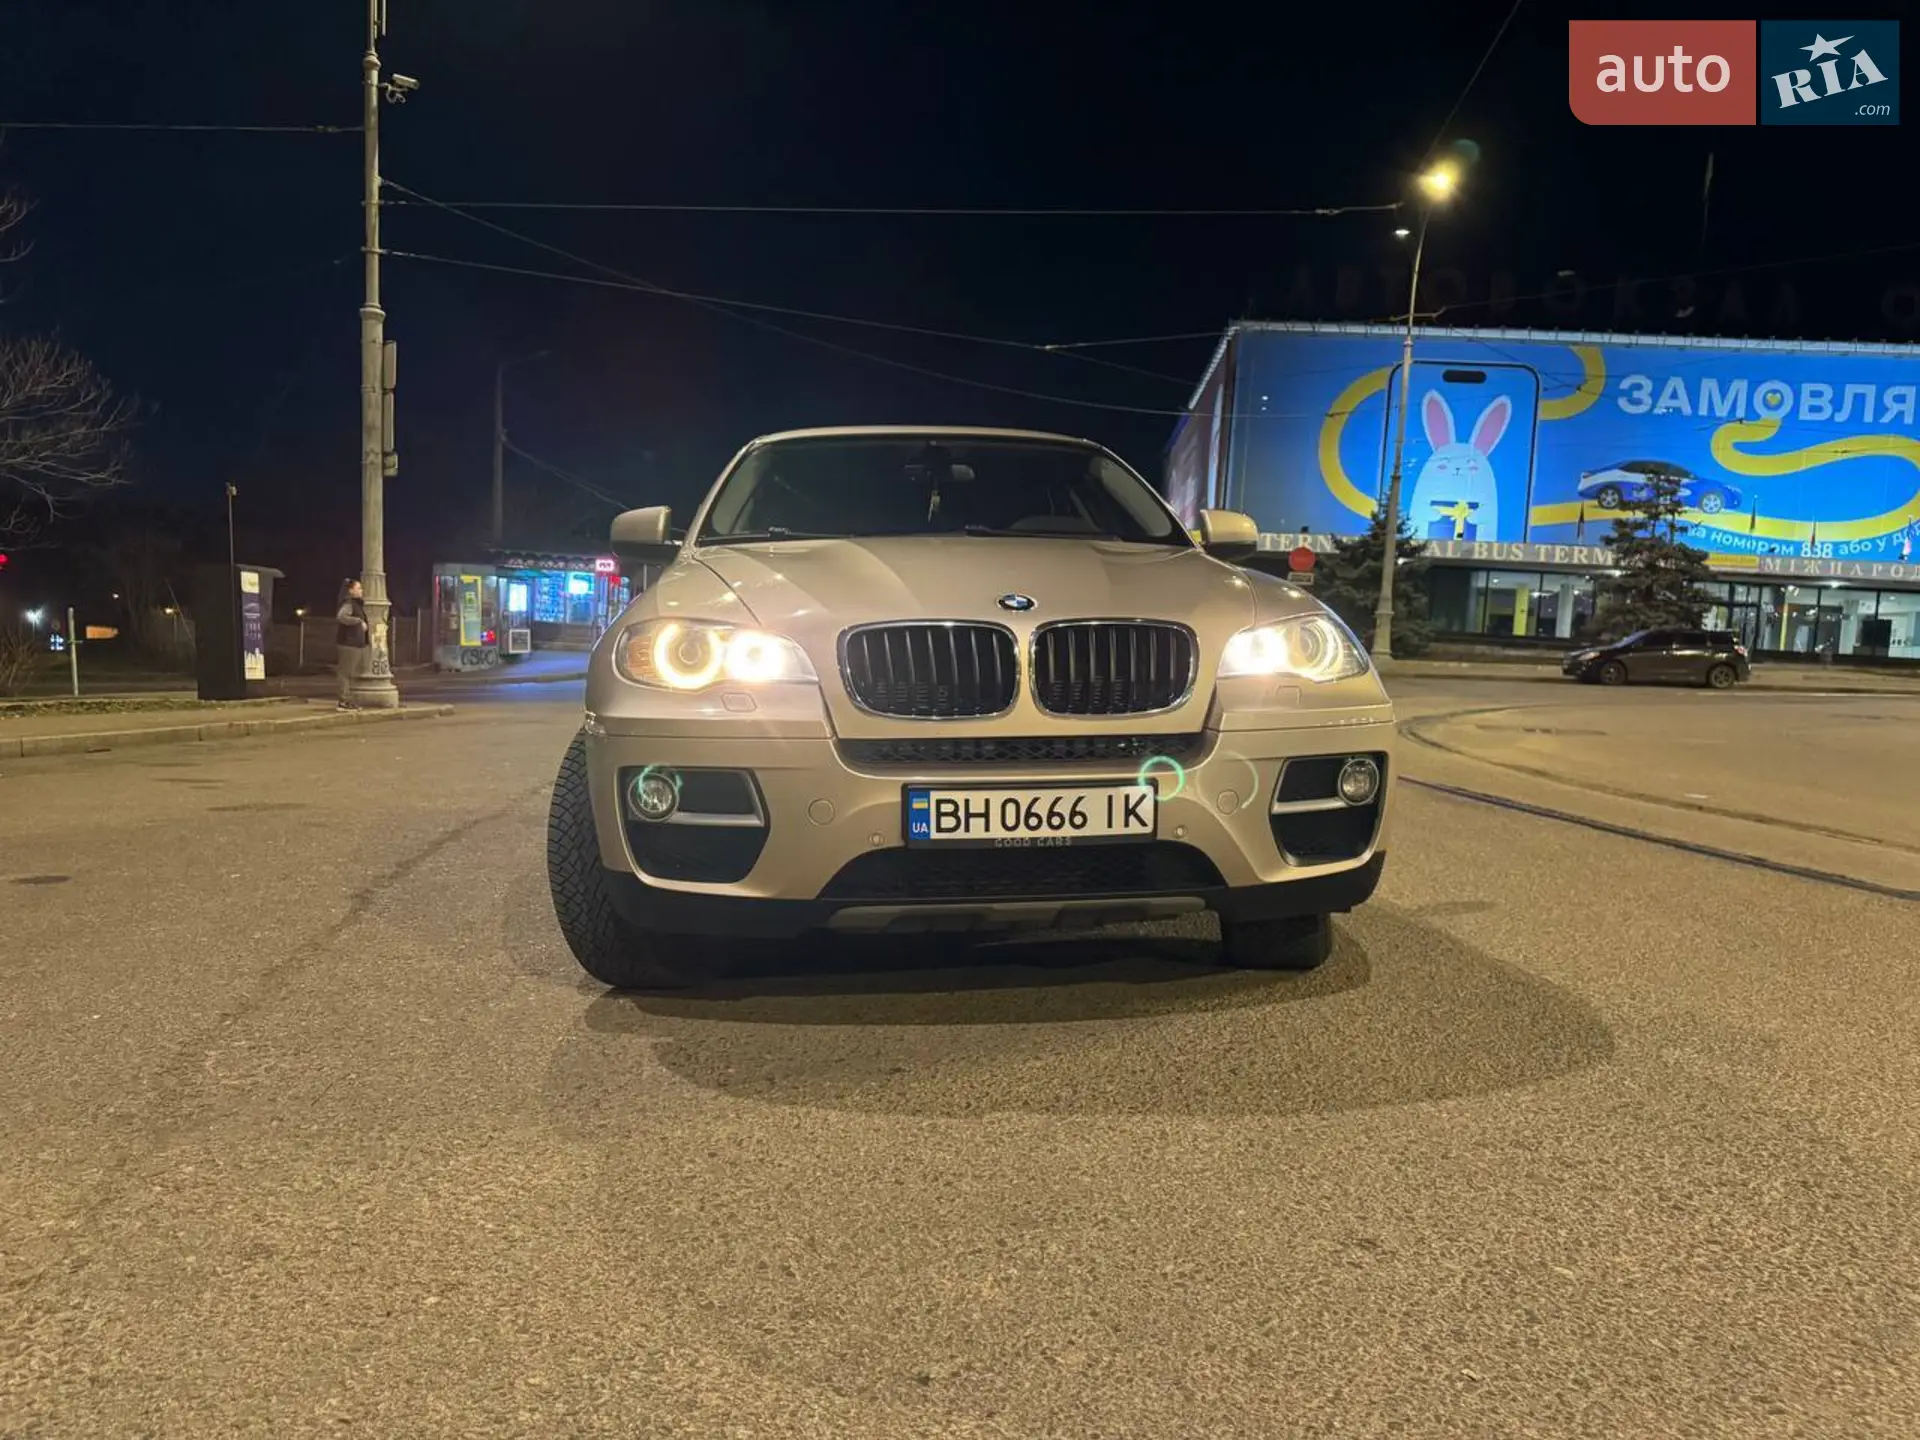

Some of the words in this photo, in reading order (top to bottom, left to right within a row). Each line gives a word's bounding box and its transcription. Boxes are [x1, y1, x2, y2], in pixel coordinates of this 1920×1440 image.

[1617, 374, 1916, 424] ЗАМОВЛЯ
[1472, 541, 1526, 560] BUS
[1801, 542, 1833, 558] 838
[1838, 539, 1872, 555] або
[1876, 538, 1887, 552] у
[912, 822, 928, 833] UA
[1037, 836, 1072, 847] CARS
